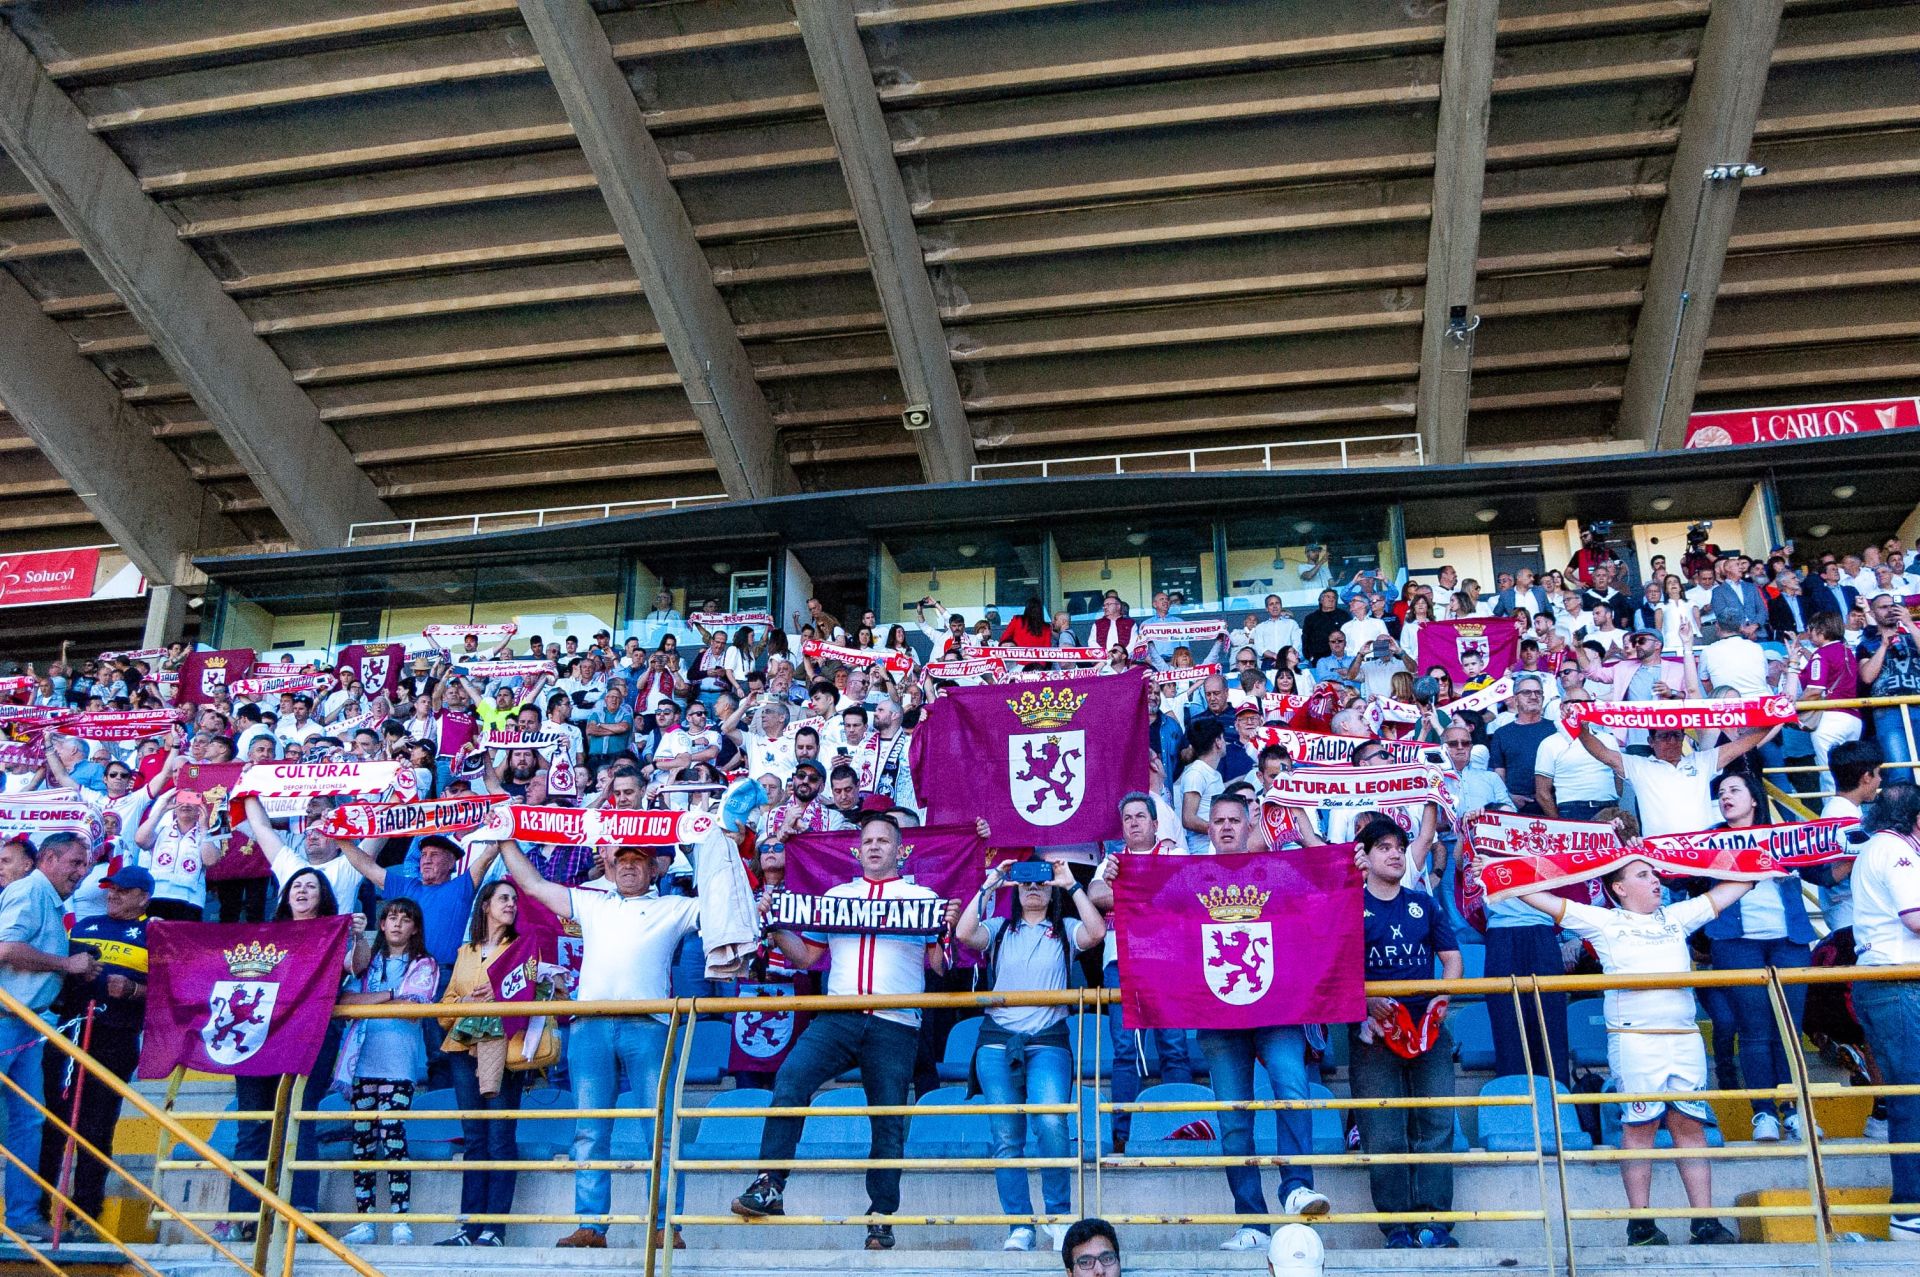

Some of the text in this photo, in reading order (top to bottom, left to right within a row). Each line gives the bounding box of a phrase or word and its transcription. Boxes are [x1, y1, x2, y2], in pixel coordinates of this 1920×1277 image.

[1751, 409, 1858, 443] J. CARLOS
[25, 568, 75, 583] Solucyl
[1142, 625, 1221, 636] CULTURAL LEONESA
[821, 651, 855, 664] ORGULLO
[855, 658, 866, 666] DE
[989, 650, 1081, 659] CULTURAL LEONESA
[1170, 667, 1210, 679] LEONESA
[1601, 707, 1747, 728] ORGULLO DE LEÓN
[78, 728, 140, 737] LEONESA
[488, 731, 520, 745] Aupa
[274, 764, 361, 779] CULTURAL
[1273, 778, 1350, 795] ULTURAL
[1322, 798, 1374, 808] Reino de León
[380, 805, 426, 834] ¡AUPA
[434, 800, 491, 830] CULTU!
[1769, 824, 1840, 861] CULTU!
[821, 897, 949, 929] RAMPANTE
[1369, 943, 1426, 959] ARVA
